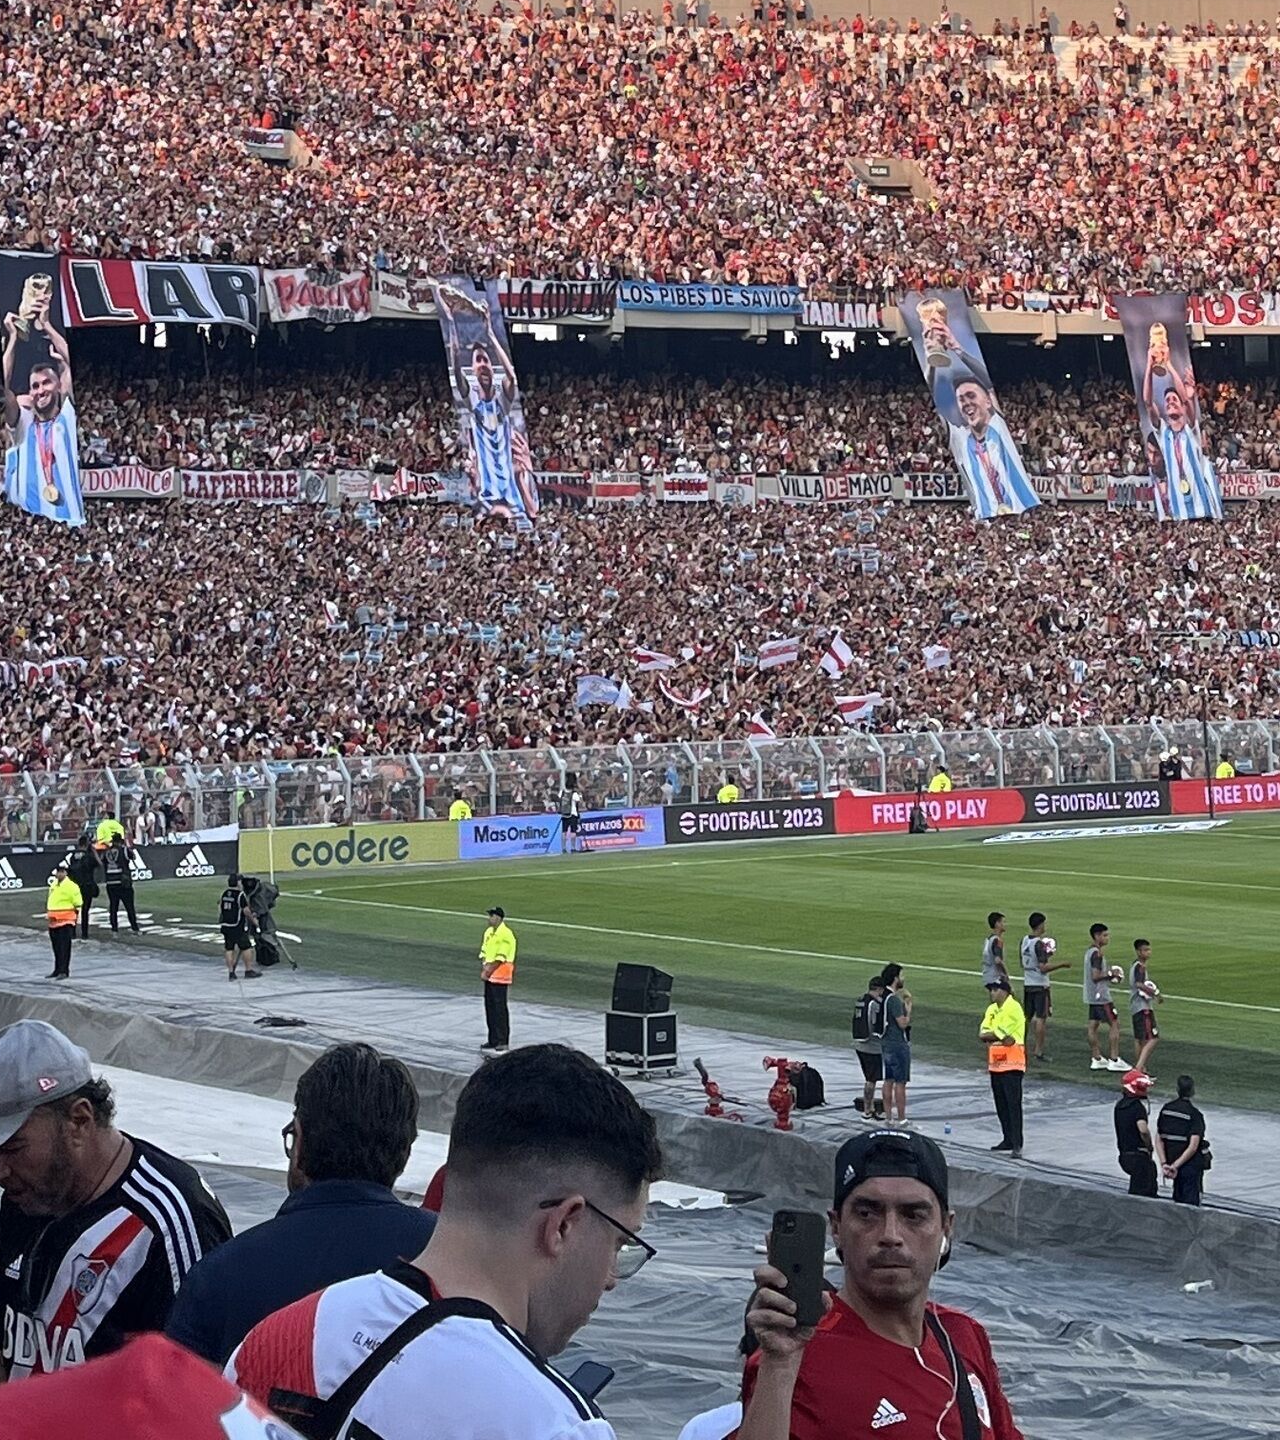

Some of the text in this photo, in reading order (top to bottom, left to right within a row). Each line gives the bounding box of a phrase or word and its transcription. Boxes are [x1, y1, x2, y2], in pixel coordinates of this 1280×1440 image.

[620, 285, 792, 309] LOS PIBES DE SAVIO
[801, 299, 880, 328] TABLADA
[181, 469, 299, 500] LAFERRERE
[779, 475, 822, 498] VILLA
[825, 476, 847, 498] DE
[848, 474, 892, 497] MAYO
[1124, 790, 1161, 810] 2023
[1204, 782, 1242, 806] FREE
[1243, 781, 1265, 803] TO
[782, 807, 824, 829] 2023
[944, 798, 988, 821] PLAY
[473, 824, 550, 844] MasOnline
[623, 817, 645, 831] XXL
[291, 828, 410, 868] codere
[175, 863, 215, 878] adidas
[2, 1304, 87, 1375] BBVA
[870, 1411, 908, 1429] adidas
